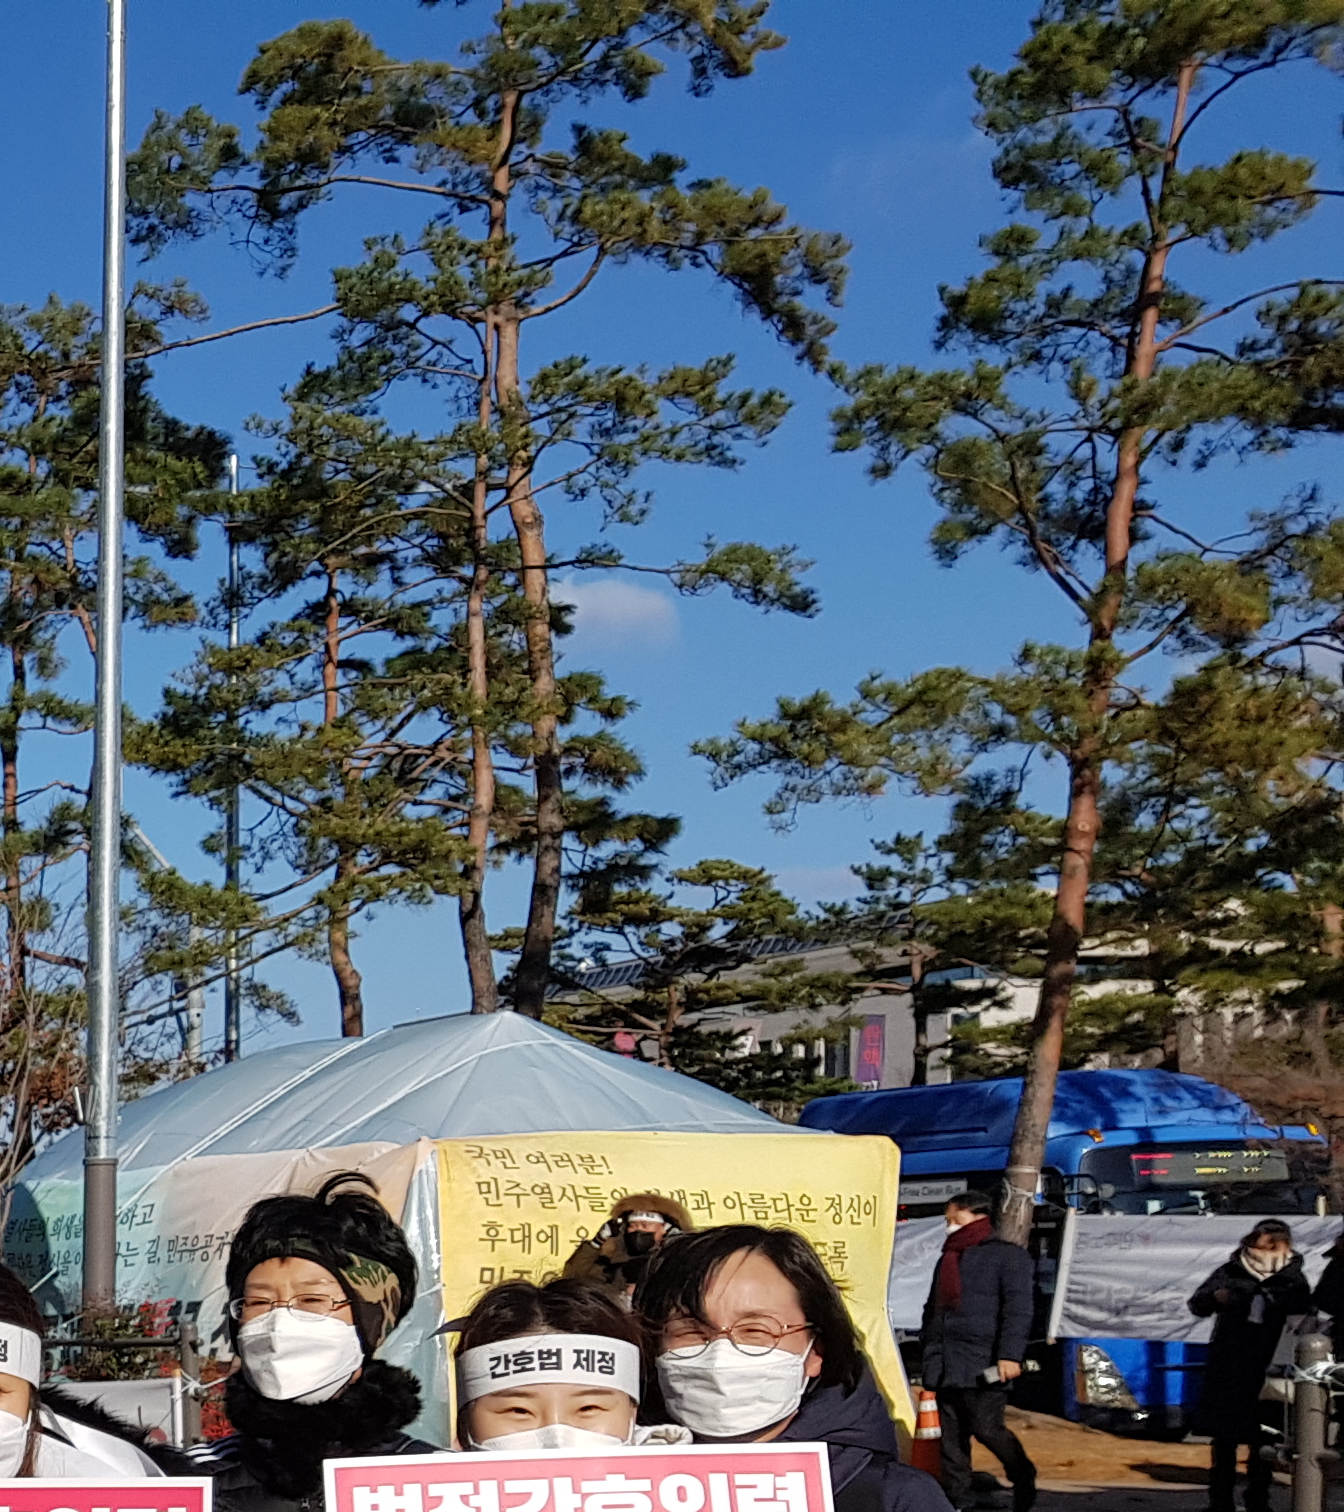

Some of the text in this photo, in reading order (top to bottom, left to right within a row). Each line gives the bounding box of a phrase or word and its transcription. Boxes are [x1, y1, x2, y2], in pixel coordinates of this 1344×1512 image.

[464, 1143, 615, 1176] 국민 여러분!
[116, 1203, 155, 1231] 하고
[722, 1190, 819, 1224] 아름다운
[824, 1193, 878, 1228] 정신이
[478, 1219, 560, 1257] 후대에
[488, 1347, 616, 1380] 간호법 제정
